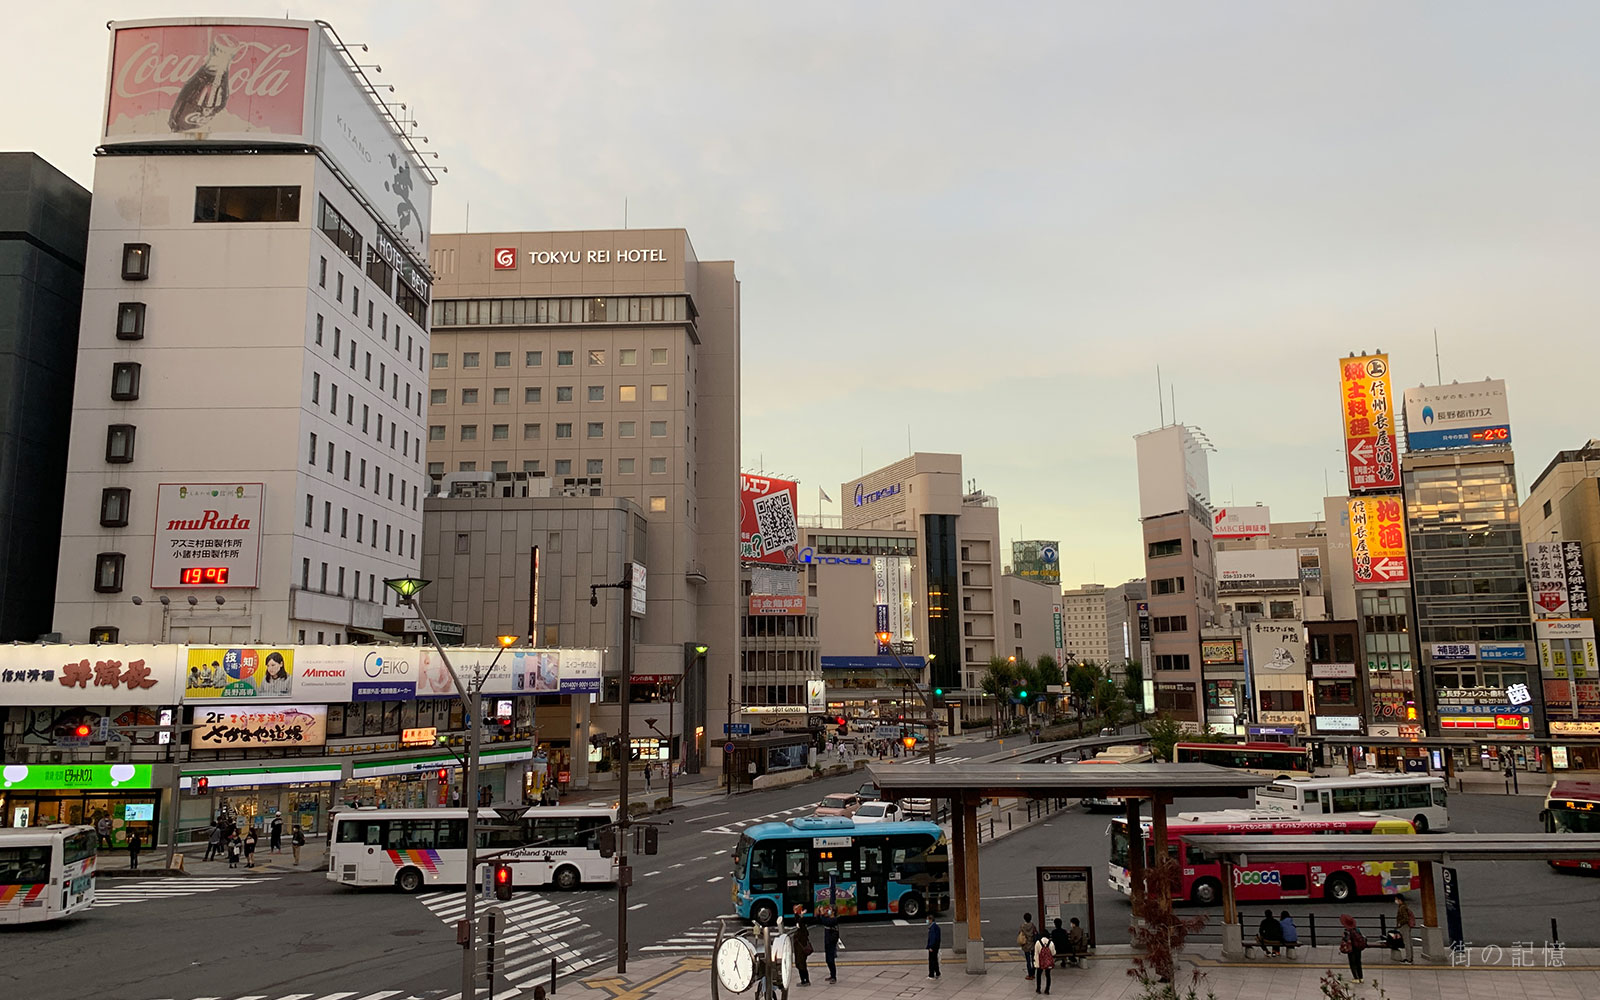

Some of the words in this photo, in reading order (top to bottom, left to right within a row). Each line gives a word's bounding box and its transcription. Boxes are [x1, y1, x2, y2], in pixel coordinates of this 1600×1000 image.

[116, 42, 206, 98] Coca
[336, 114, 372, 164] KITANO
[529, 251, 581, 264] TOKYU
[587, 250, 610, 263] REI
[617, 249, 667, 262] HOTEL
[379, 233, 404, 276] HOTEL
[411, 269, 428, 301] BEST
[1344, 363, 1371, 437] 郷土料理
[1438, 408, 1492, 420] 長野都市ガス
[1370, 380, 1395, 482] 信州長屋酒場
[864, 483, 900, 504] TOKYU
[166, 510, 250, 530] muRata
[1215, 524, 1267, 533] SMBC日興証券
[1376, 498, 1403, 549] 地酒
[1352, 500, 1372, 579] 信州長屋酒場
[173, 550, 240, 559] 小諸村田製作所
[814, 556, 871, 565] TOKYU
[1539, 545, 1551, 579] 飲み放題
[1551, 544, 1564, 579] 信州地酒
[1563, 542, 1588, 612] 長野県の郷土料理
[1437, 645, 1470, 655] 補聴器
[302, 668, 346, 678] Mimaki
[224, 688, 254, 696] 長野高専
[1447, 690, 1504, 698] 長野フォレスト歯科
[1506, 683, 1531, 705] 歯
[420, 701, 432, 713] 2F
[206, 712, 225, 723] 2F
[202, 725, 304, 743] さかなや道場
[506, 849, 539, 857] Highland
[541, 849, 567, 857] Shuttle
